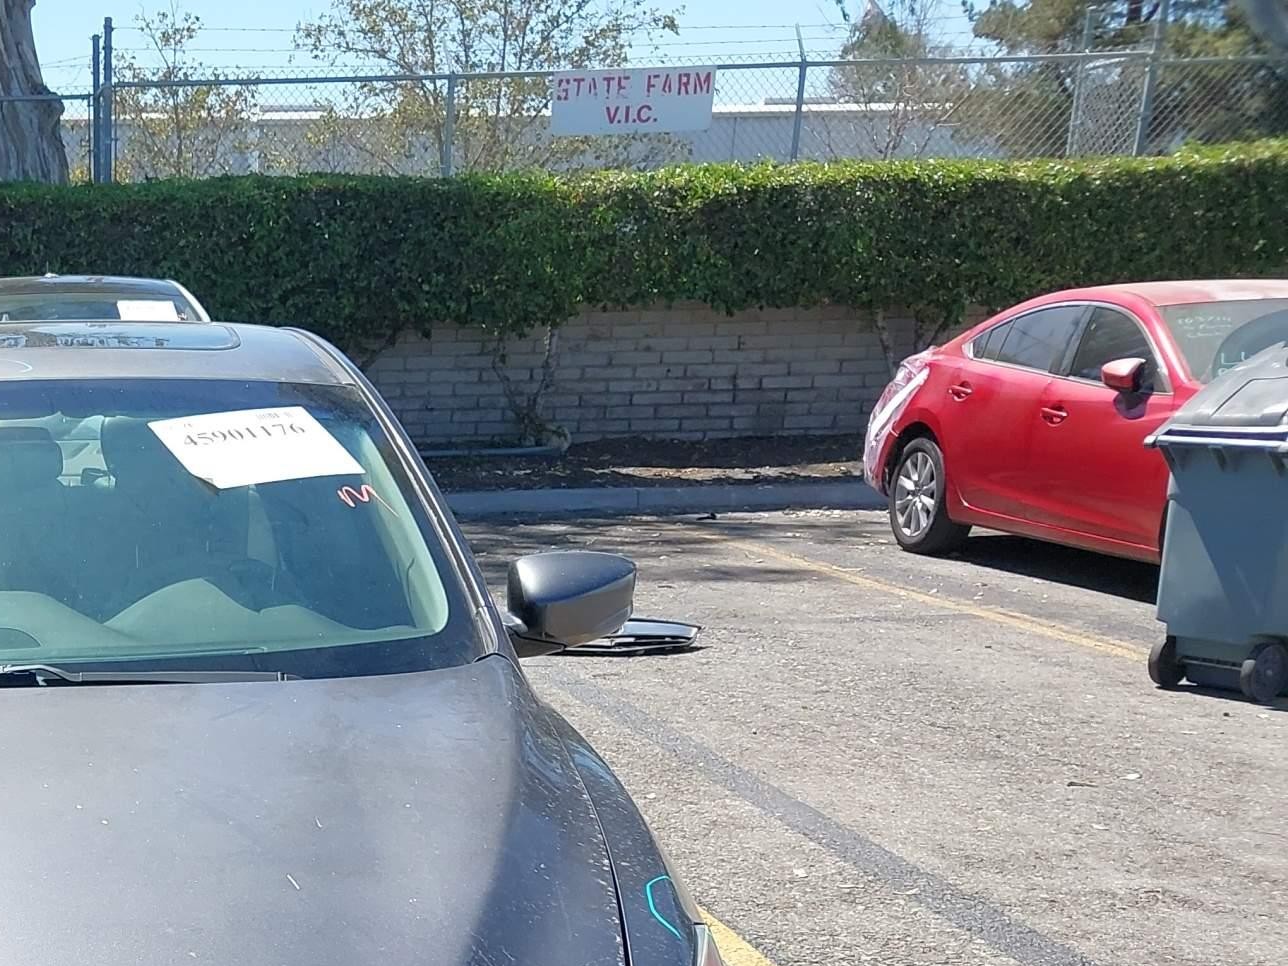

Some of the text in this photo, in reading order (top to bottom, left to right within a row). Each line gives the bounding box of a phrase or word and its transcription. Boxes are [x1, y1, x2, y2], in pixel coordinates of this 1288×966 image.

[556, 71, 712, 100] STATE FARM
[605, 104, 658, 124] V.I.C.
[183, 423, 307, 446] 45901176
